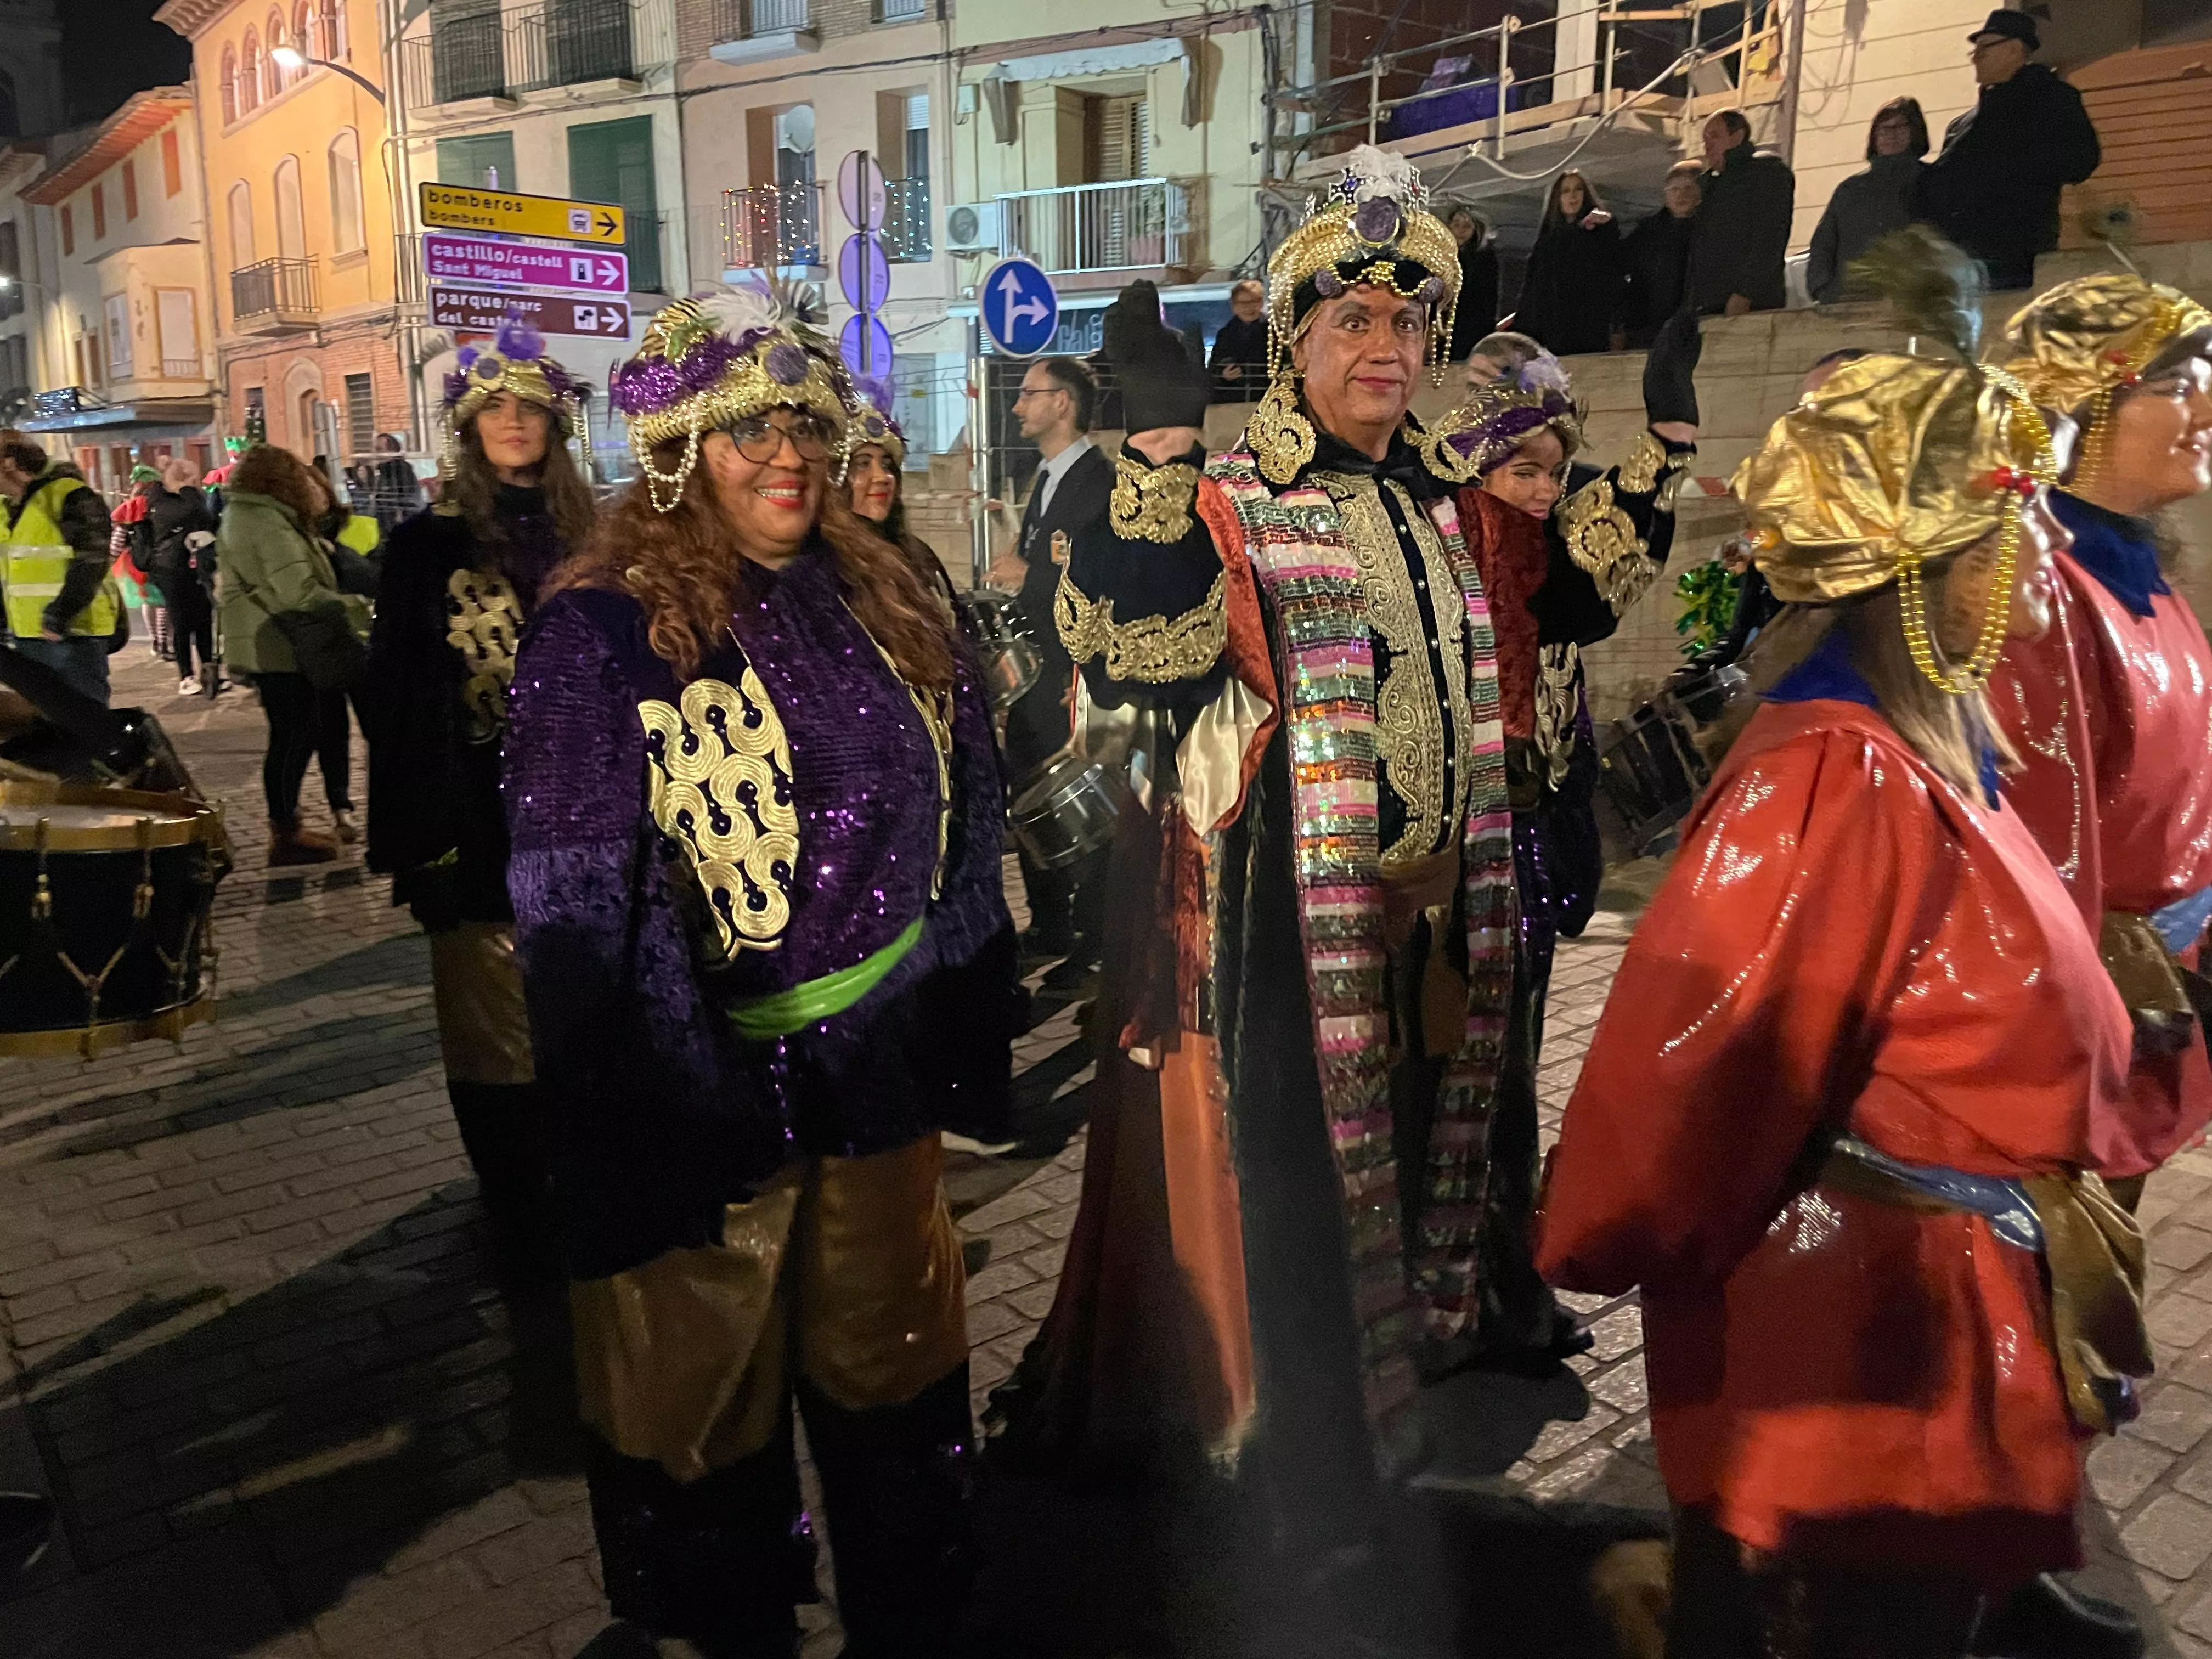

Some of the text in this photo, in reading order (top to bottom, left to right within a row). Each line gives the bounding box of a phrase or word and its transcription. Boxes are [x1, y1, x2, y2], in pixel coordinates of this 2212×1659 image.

[429, 189, 523, 212] bomberos
[430, 210, 495, 226] bombers
[437, 312, 523, 328] del castl
